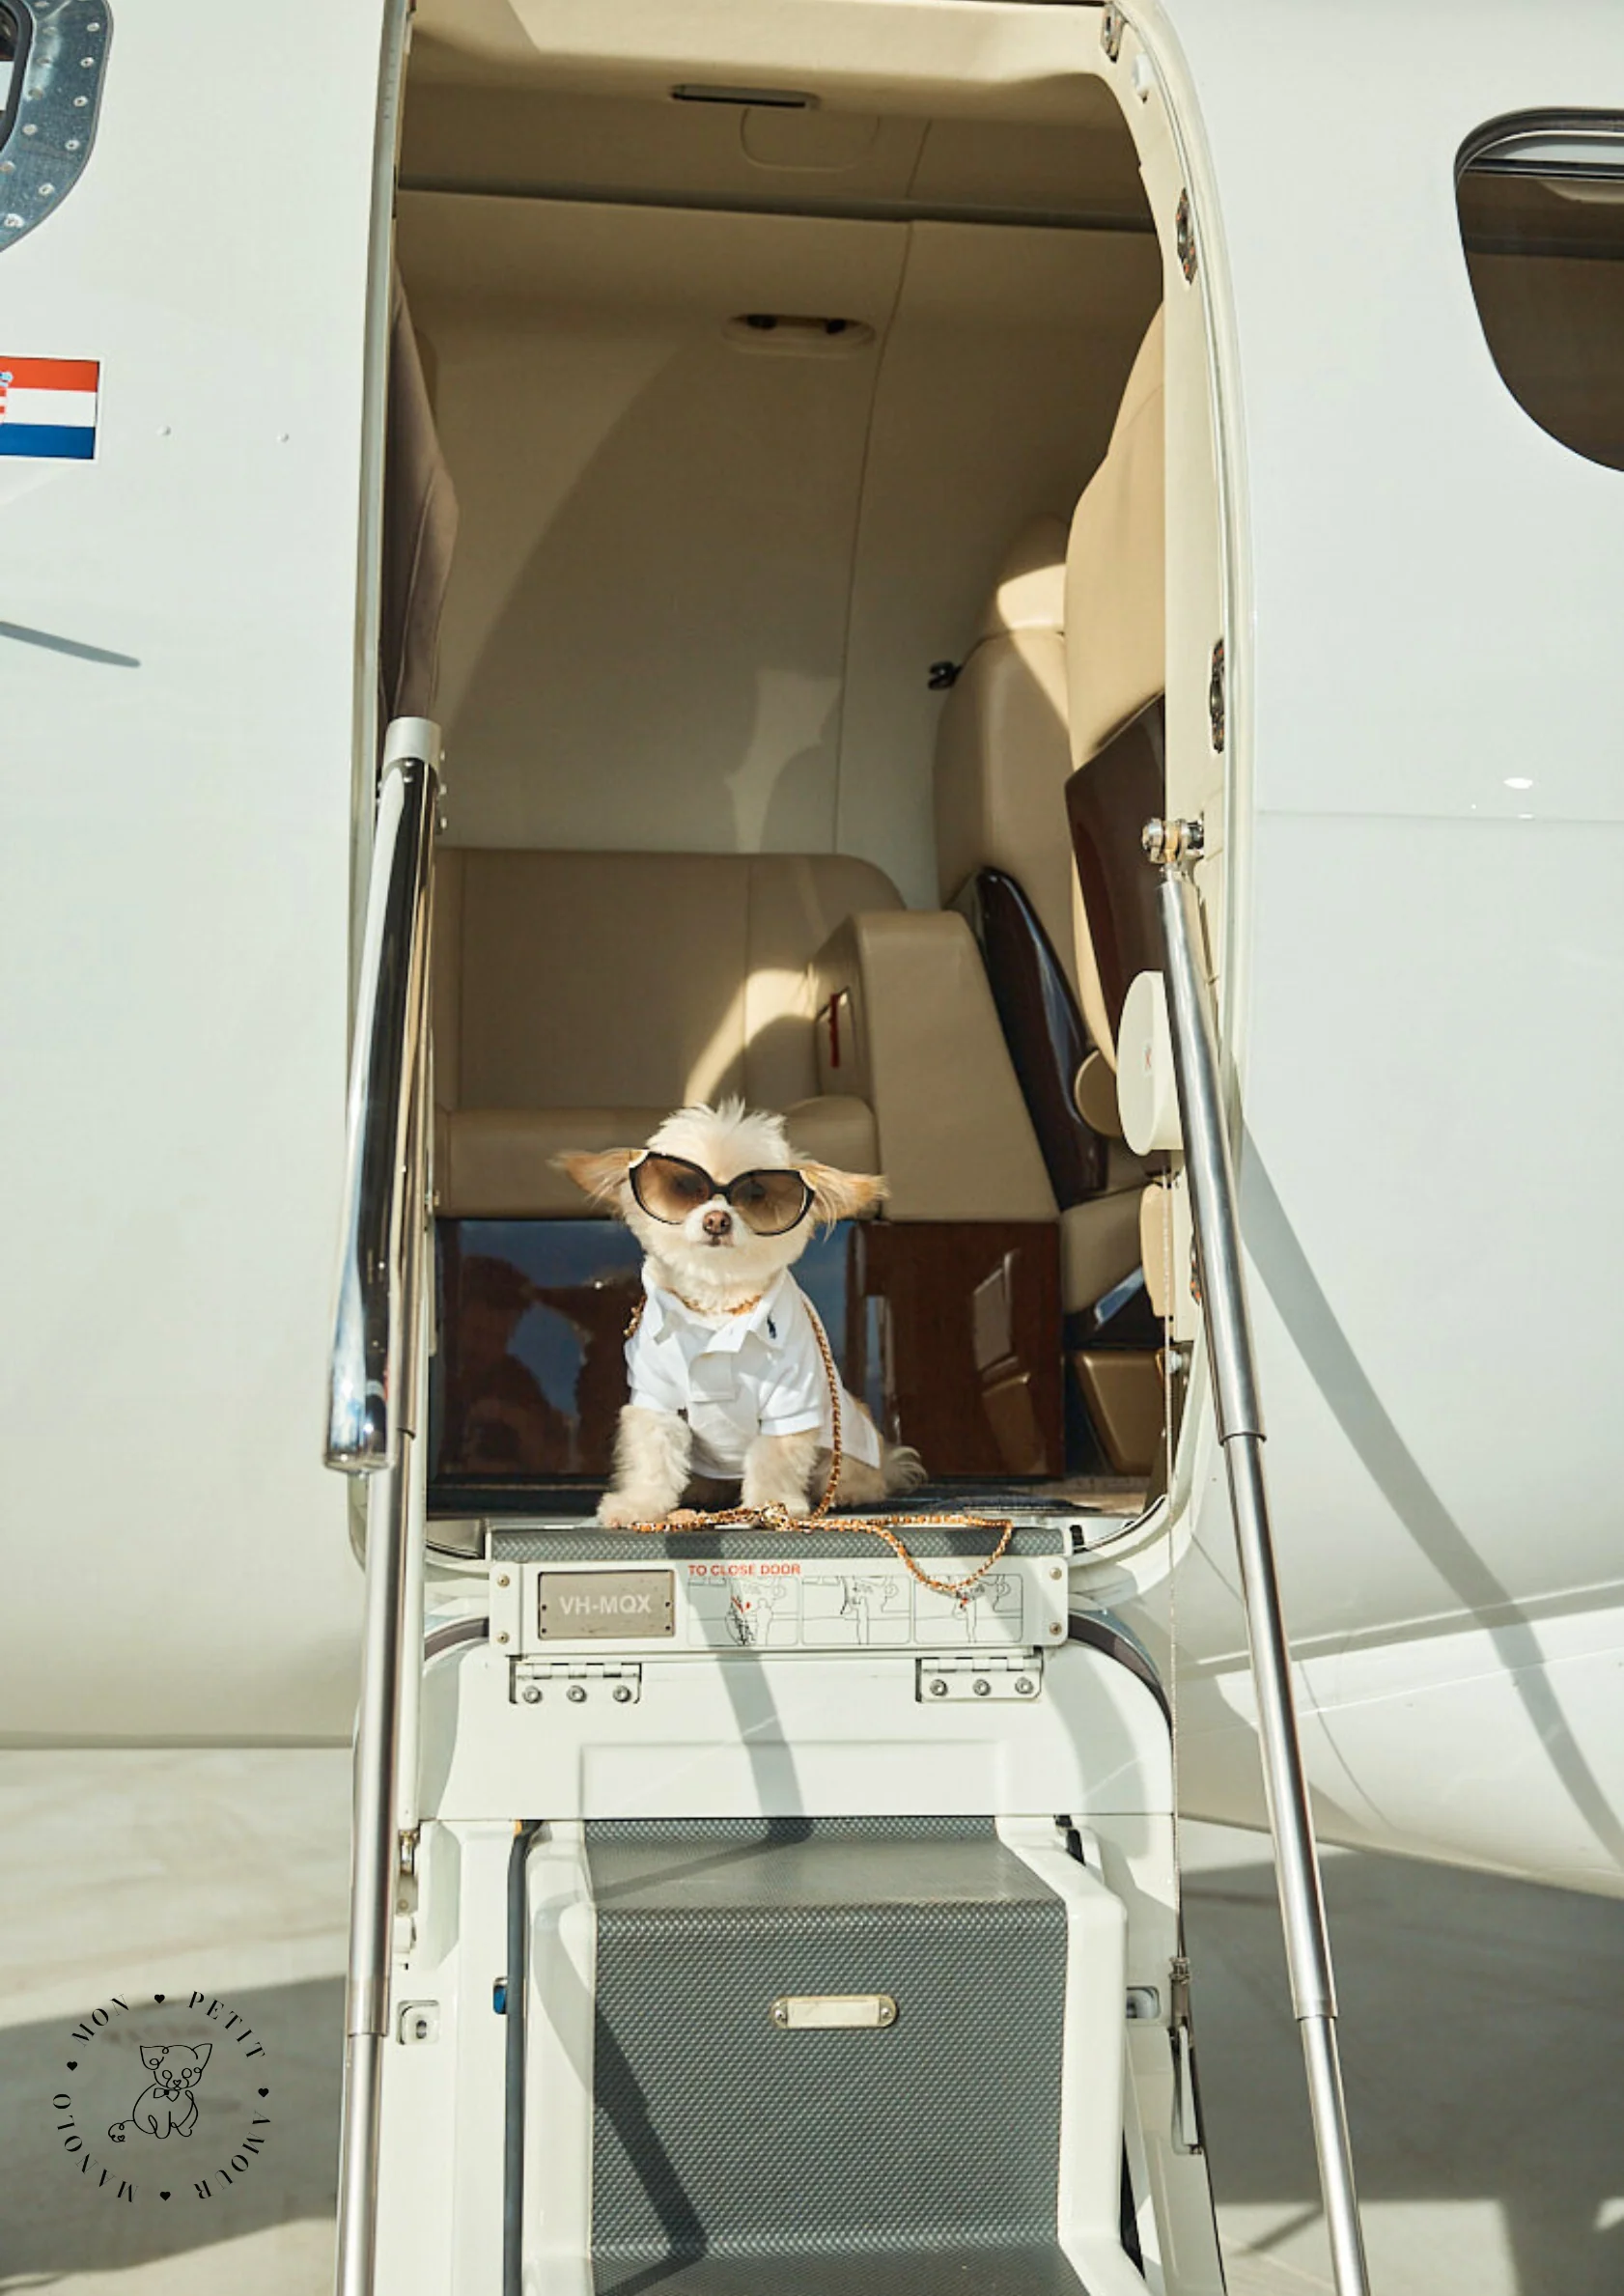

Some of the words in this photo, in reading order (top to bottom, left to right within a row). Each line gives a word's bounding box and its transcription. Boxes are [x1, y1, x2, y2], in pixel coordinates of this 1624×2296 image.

[687, 1564, 707, 1577] TO
[710, 1564, 755, 1576] CLOSE
[760, 1563, 801, 1575] DOOR
[559, 1594, 652, 1615] VH-MQX
